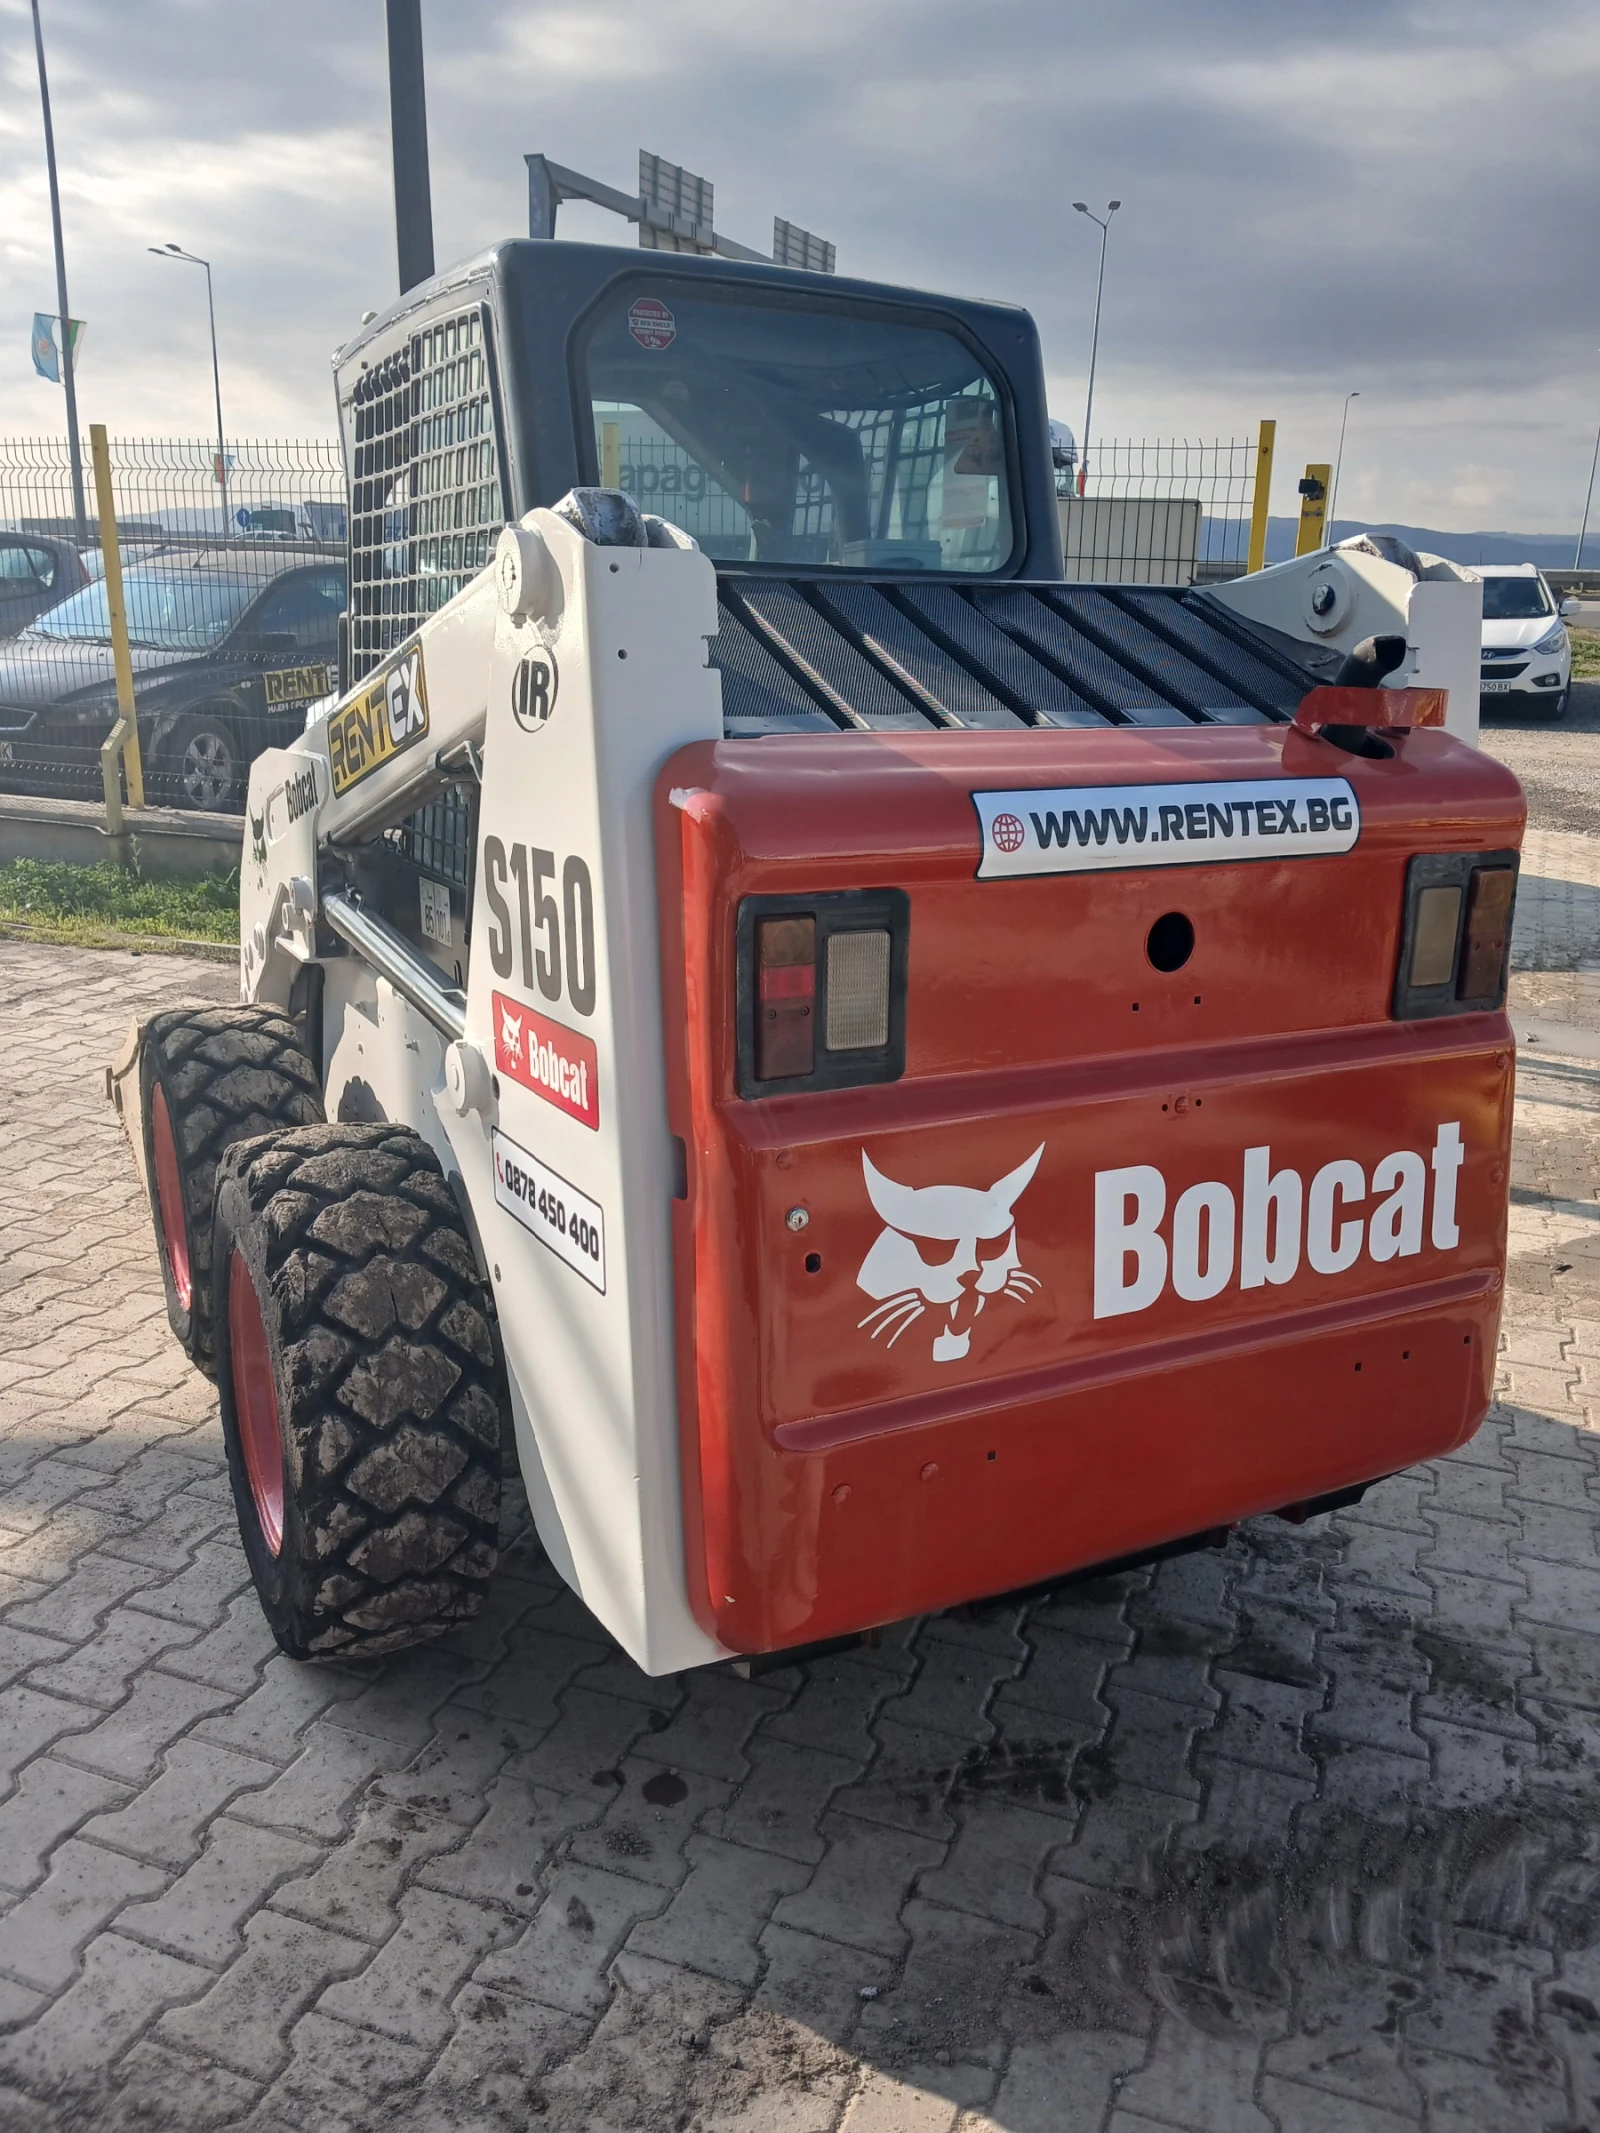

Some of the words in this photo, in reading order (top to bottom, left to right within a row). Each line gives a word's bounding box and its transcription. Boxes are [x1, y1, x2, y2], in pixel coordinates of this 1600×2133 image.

[329, 653, 425, 787] RENTEX
[518, 658, 550, 721] IR
[284, 760, 319, 825] Bobcat
[1029, 796, 1353, 850] WWW.RENTEX.BG
[483, 834, 596, 1017] S150
[528, 1028, 589, 1111] Bobcat
[505, 1158, 536, 1211] 0878
[538, 1187, 566, 1236] 450
[569, 1212, 600, 1263] 400
[1094, 1121, 1464, 1319] Bobcat
